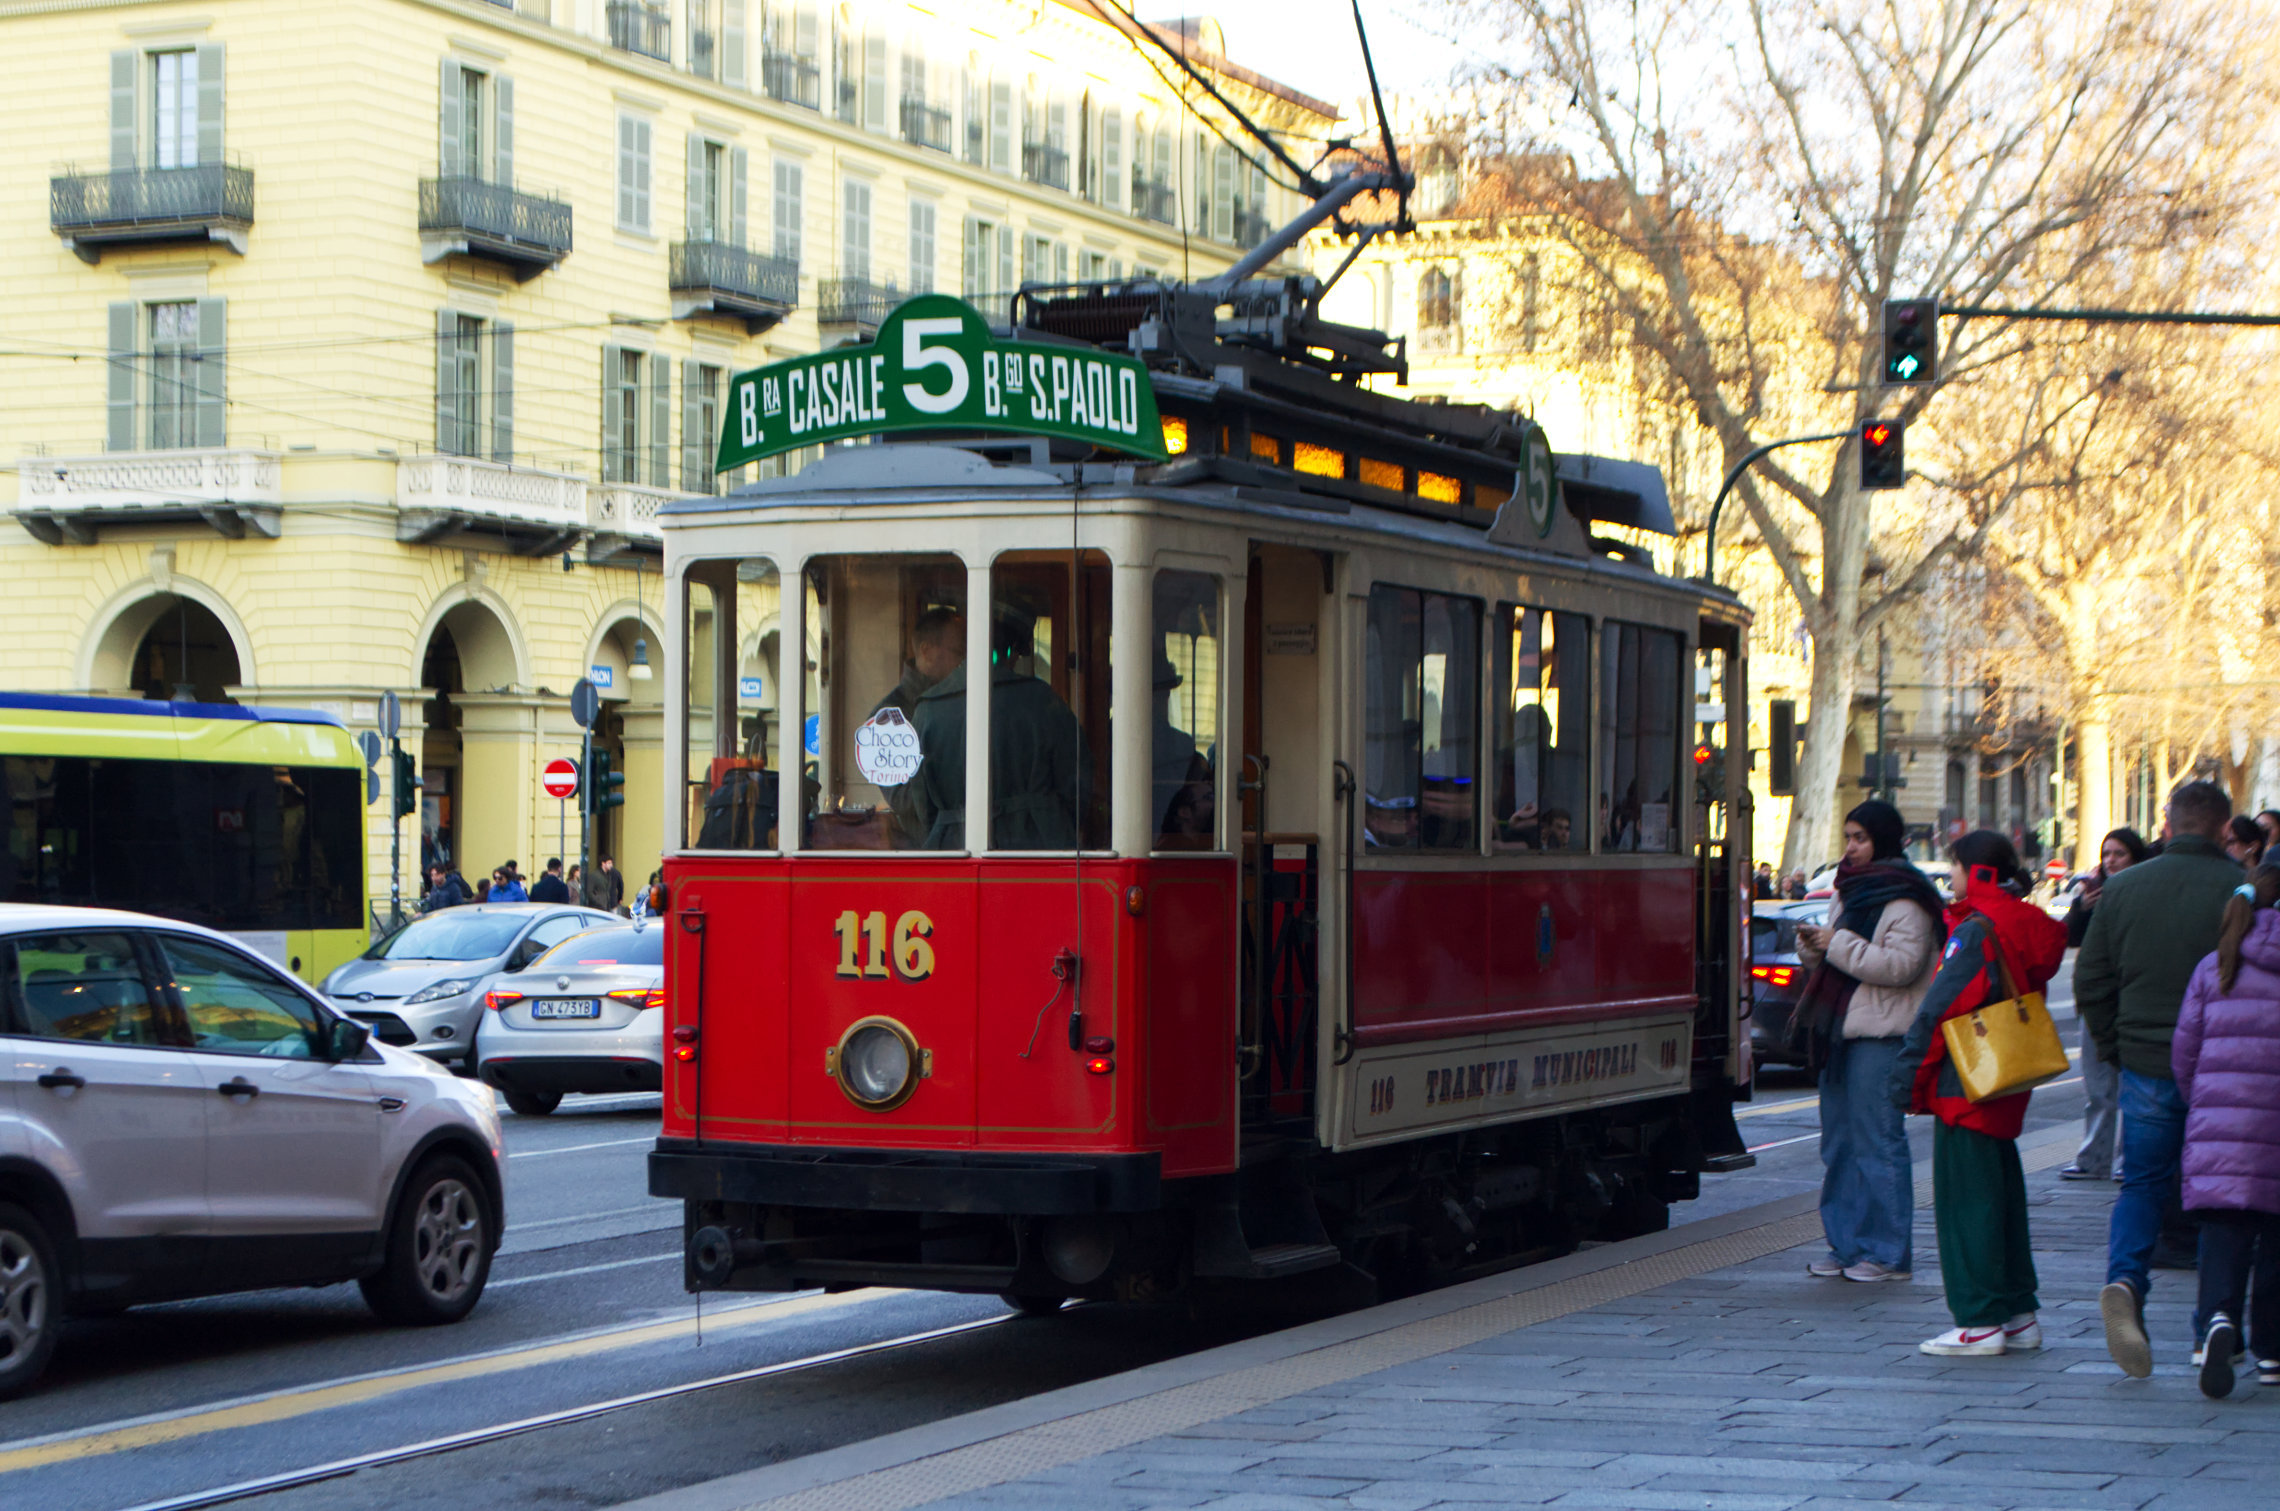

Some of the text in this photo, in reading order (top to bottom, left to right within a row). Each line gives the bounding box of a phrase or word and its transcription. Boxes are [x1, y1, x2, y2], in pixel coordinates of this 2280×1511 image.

[788, 355, 886, 435] CASALE
[903, 317, 969, 414] 5
[1529, 441, 1549, 525] 5
[856, 726, 915, 748] Choco
[874, 748, 923, 777] Story
[865, 770, 909, 783] Torino
[833, 909, 936, 984] 116
[1369, 1075, 1395, 1117] 116
[1425, 1042, 1639, 1107] TRAMVIE MUNICIPALI
